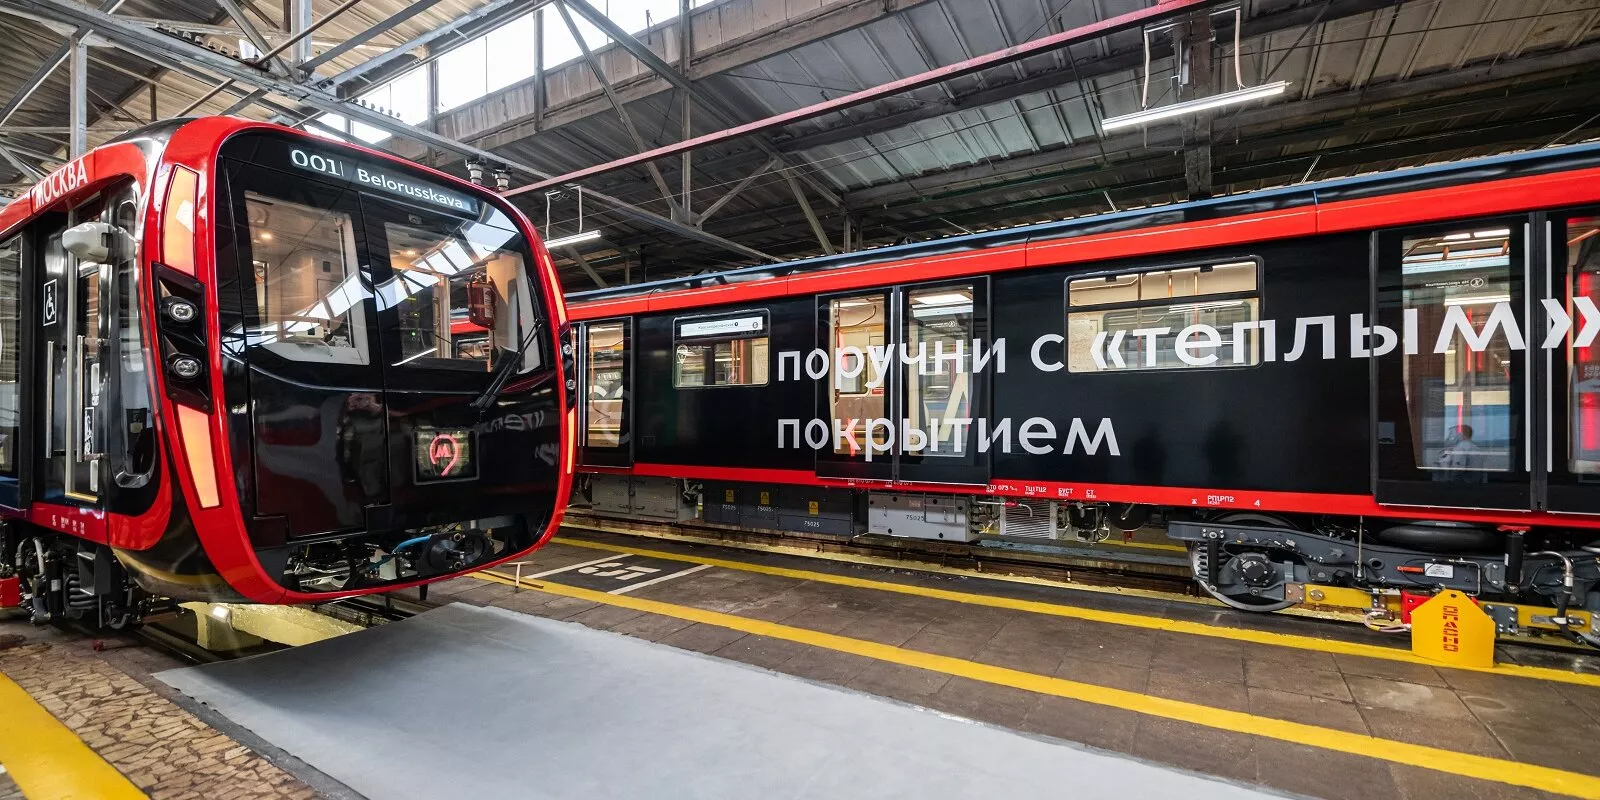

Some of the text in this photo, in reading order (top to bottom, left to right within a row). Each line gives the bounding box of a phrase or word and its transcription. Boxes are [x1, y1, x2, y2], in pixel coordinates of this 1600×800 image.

[32, 158, 88, 209] МОСКВА
[778, 296, 1600, 389] поручни с «теплым»
[777, 416, 1121, 462] покрытием
[1254, 499, 1261, 507] 4
[803, 520, 820, 528] 75025
[577, 562, 662, 581] 5
